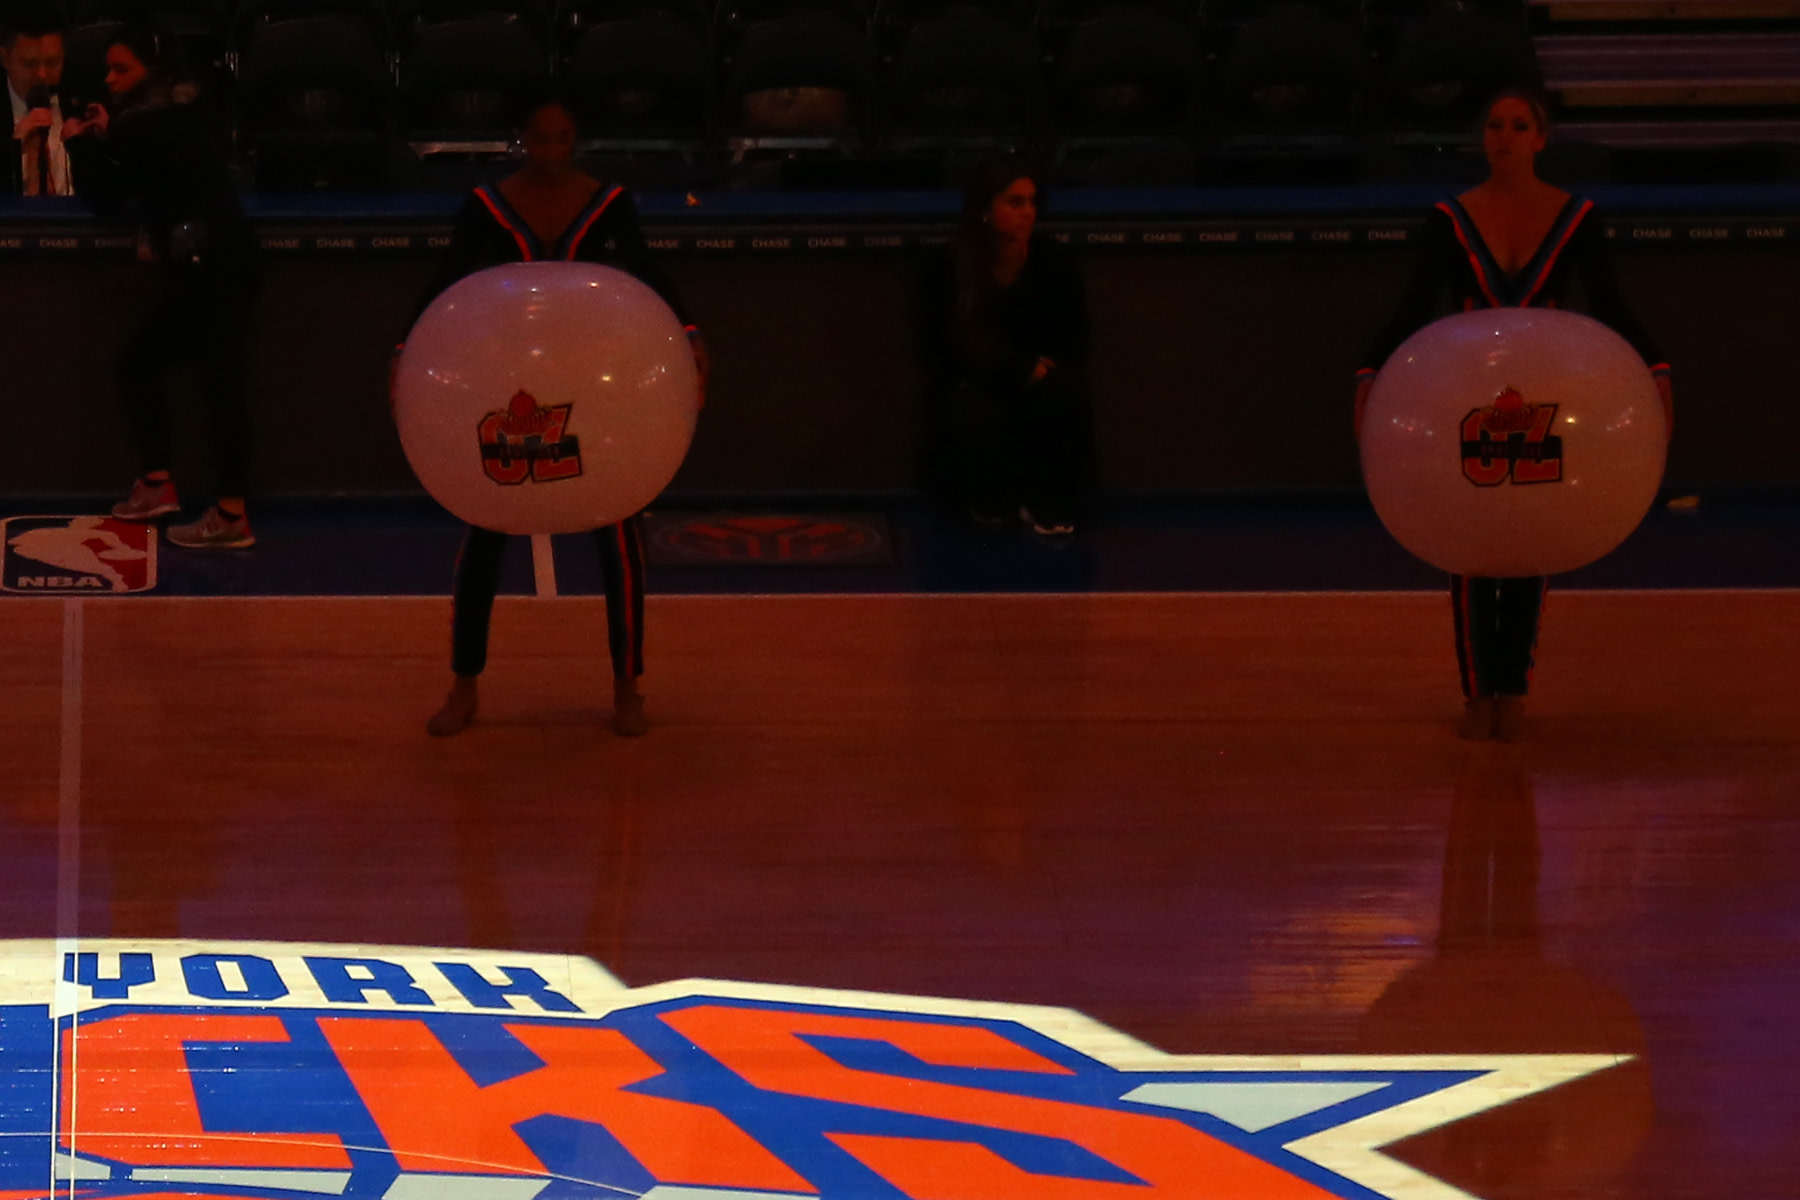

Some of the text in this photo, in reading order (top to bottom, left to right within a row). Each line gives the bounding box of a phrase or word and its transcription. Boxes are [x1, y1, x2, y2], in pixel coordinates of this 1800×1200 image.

[39, 237, 79, 249] CHASE
[260, 237, 300, 249] CHASE
[315, 237, 356, 249] CHASE
[371, 236, 411, 248] CHASE
[645, 238, 680, 249] HASE
[695, 238, 735, 249] CHASE
[751, 238, 791, 249] CHASE
[807, 237, 847, 248] CHASE
[1086, 232, 1127, 244] CHASE
[1142, 232, 1183, 244] CHASE
[1198, 231, 1239, 243] CHASE
[1255, 230, 1295, 242] CHASE
[1311, 230, 1351, 241] CHASE
[1367, 229, 1407, 241] CHASE
[1632, 227, 1673, 239] CHASE
[1688, 228, 1729, 239] CHASE
[1745, 227, 1786, 239] CHASE
[478, 404, 582, 486] 70
[1461, 405, 1563, 487] 70
[17, 576, 103, 588] NBA
[62, 951, 587, 1014] YORK
